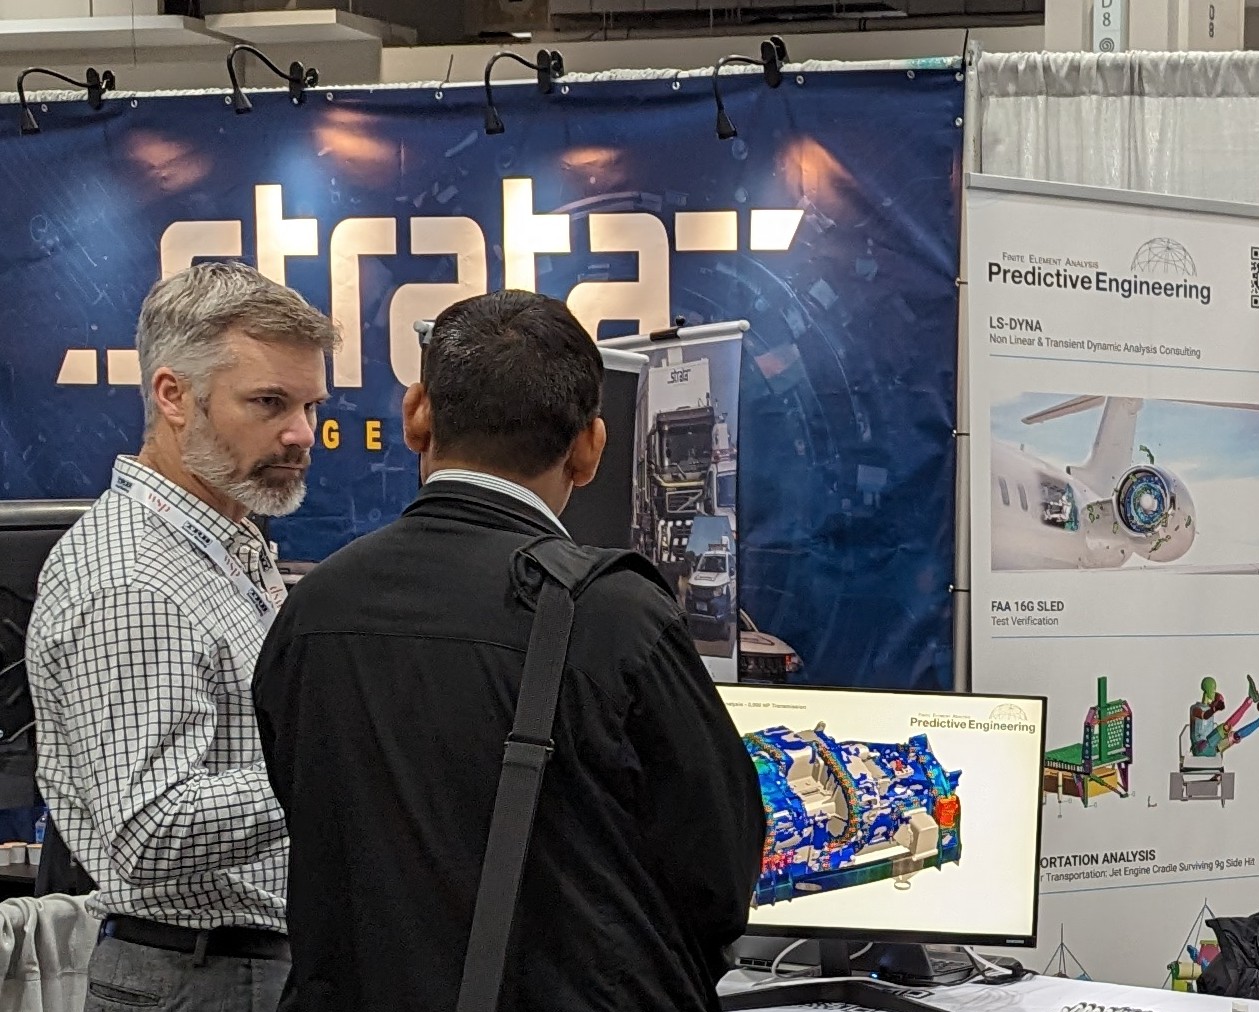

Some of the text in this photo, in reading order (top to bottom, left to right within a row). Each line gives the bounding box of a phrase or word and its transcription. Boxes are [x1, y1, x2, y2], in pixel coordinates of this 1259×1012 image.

[1002, 251, 1099, 269] FINITE ELEMENT ANALYSIS
[988, 262, 1212, 305] Predictive Engineering
[989, 316, 1043, 333] LS-DYNA
[989, 333, 1201, 360] Non Linear & Transient Dynamic Analysis Consulting
[991, 600, 1065, 612] FAA 16G SLED
[991, 616, 1059, 626] Test Verification
[910, 717, 1036, 734] Predictive Engineering
[1040, 849, 1156, 869] ORTATION ANALYSIS
[1109, 866, 1122, 877] Jet
[1124, 865, 1151, 878] Engine
[1152, 863, 1178, 874] Cradle
[1179, 860, 1214, 872] Surviving
[1226, 859, 1243, 868] Side
[1244, 857, 1256, 867] Hit
